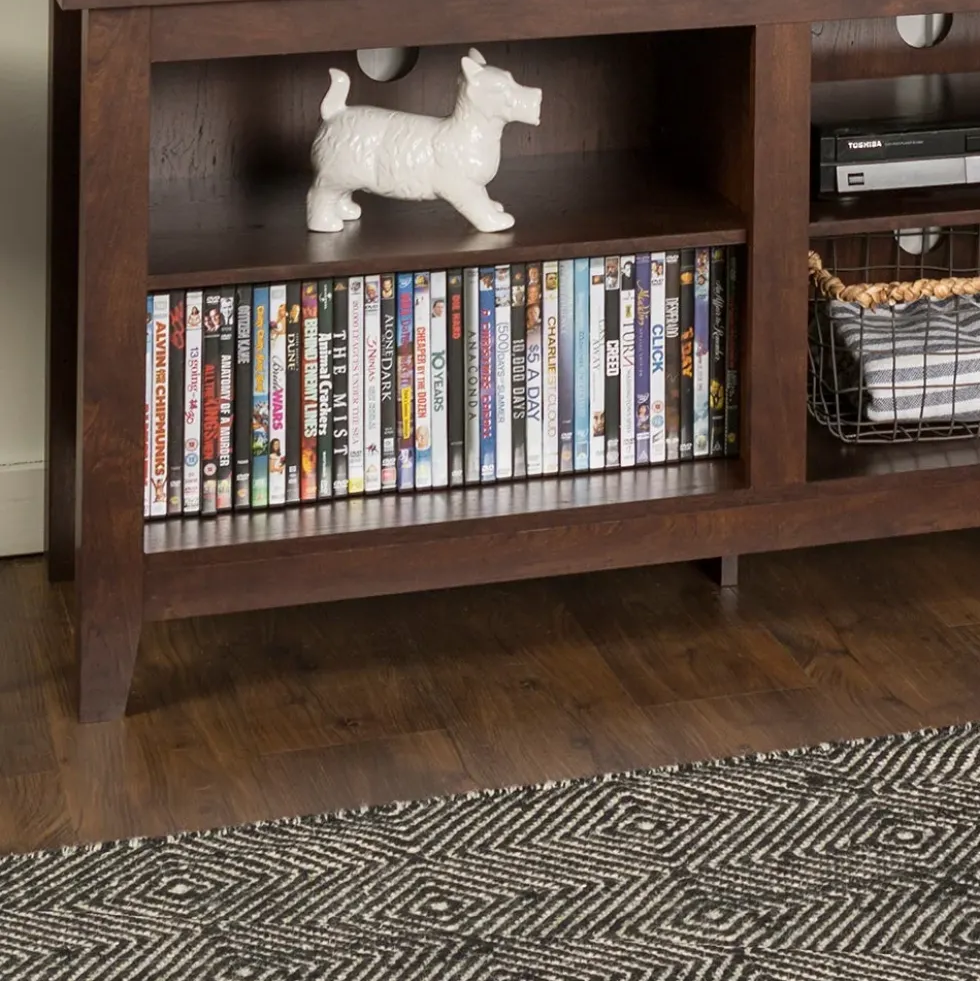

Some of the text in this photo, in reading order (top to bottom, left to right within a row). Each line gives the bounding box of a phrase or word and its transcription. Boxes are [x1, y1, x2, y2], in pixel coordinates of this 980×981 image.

[848, 140, 882, 149] TOSHIBA
[451, 294, 461, 339] DIE HARD
[636, 279, 650, 326] Aladdin
[665, 297, 679, 338] DESPERADO
[713, 293, 725, 317] Affair
[155, 321, 166, 368] ALVIN
[189, 347, 200, 359] 13
[237, 305, 250, 364] CITIZEN KANE
[287, 333, 296, 371] DUNE
[318, 332, 331, 379] Animal
[351, 329, 359, 371] LEAGUES
[384, 314, 394, 357] ALONE
[481, 322, 492, 389] CHRISTMAS
[496, 321, 509, 353] (500)
[547, 316, 557, 373] CHARLIE
[592, 339, 600, 371] AWAY
[652, 323, 664, 374] CLICK
[187, 358, 199, 393] going
[204, 363, 215, 381] ALL
[303, 318, 318, 438] BEHIND ENEMY LINES
[367, 348, 377, 382] NINJAS
[381, 357, 393, 402] DARK
[416, 326, 427, 418] CHEAPER BY THE DOZEN
[431, 349, 445, 412] 10 YEARS
[468, 330, 478, 421] ANACONDA
[497, 353, 505, 377] DAYS
[511, 338, 525, 420] 10,000 DAYS
[607, 340, 619, 376] CREED
[272, 355, 284, 431] Bride WARS
[333, 329, 348, 456] THE MIST
[352, 372, 360, 405] UNDER
[497, 384, 505, 423] SUMMER
[527, 344, 540, 422] $5 A DAY
[154, 384, 166, 477] CHIPMUNKS
[219, 354, 232, 467] ANATOMY OF A MURDER
[318, 380, 332, 436] Crackers
[352, 407, 360, 425] THE
[547, 393, 557, 438] CLOUD
[352, 427, 360, 445] SEA
